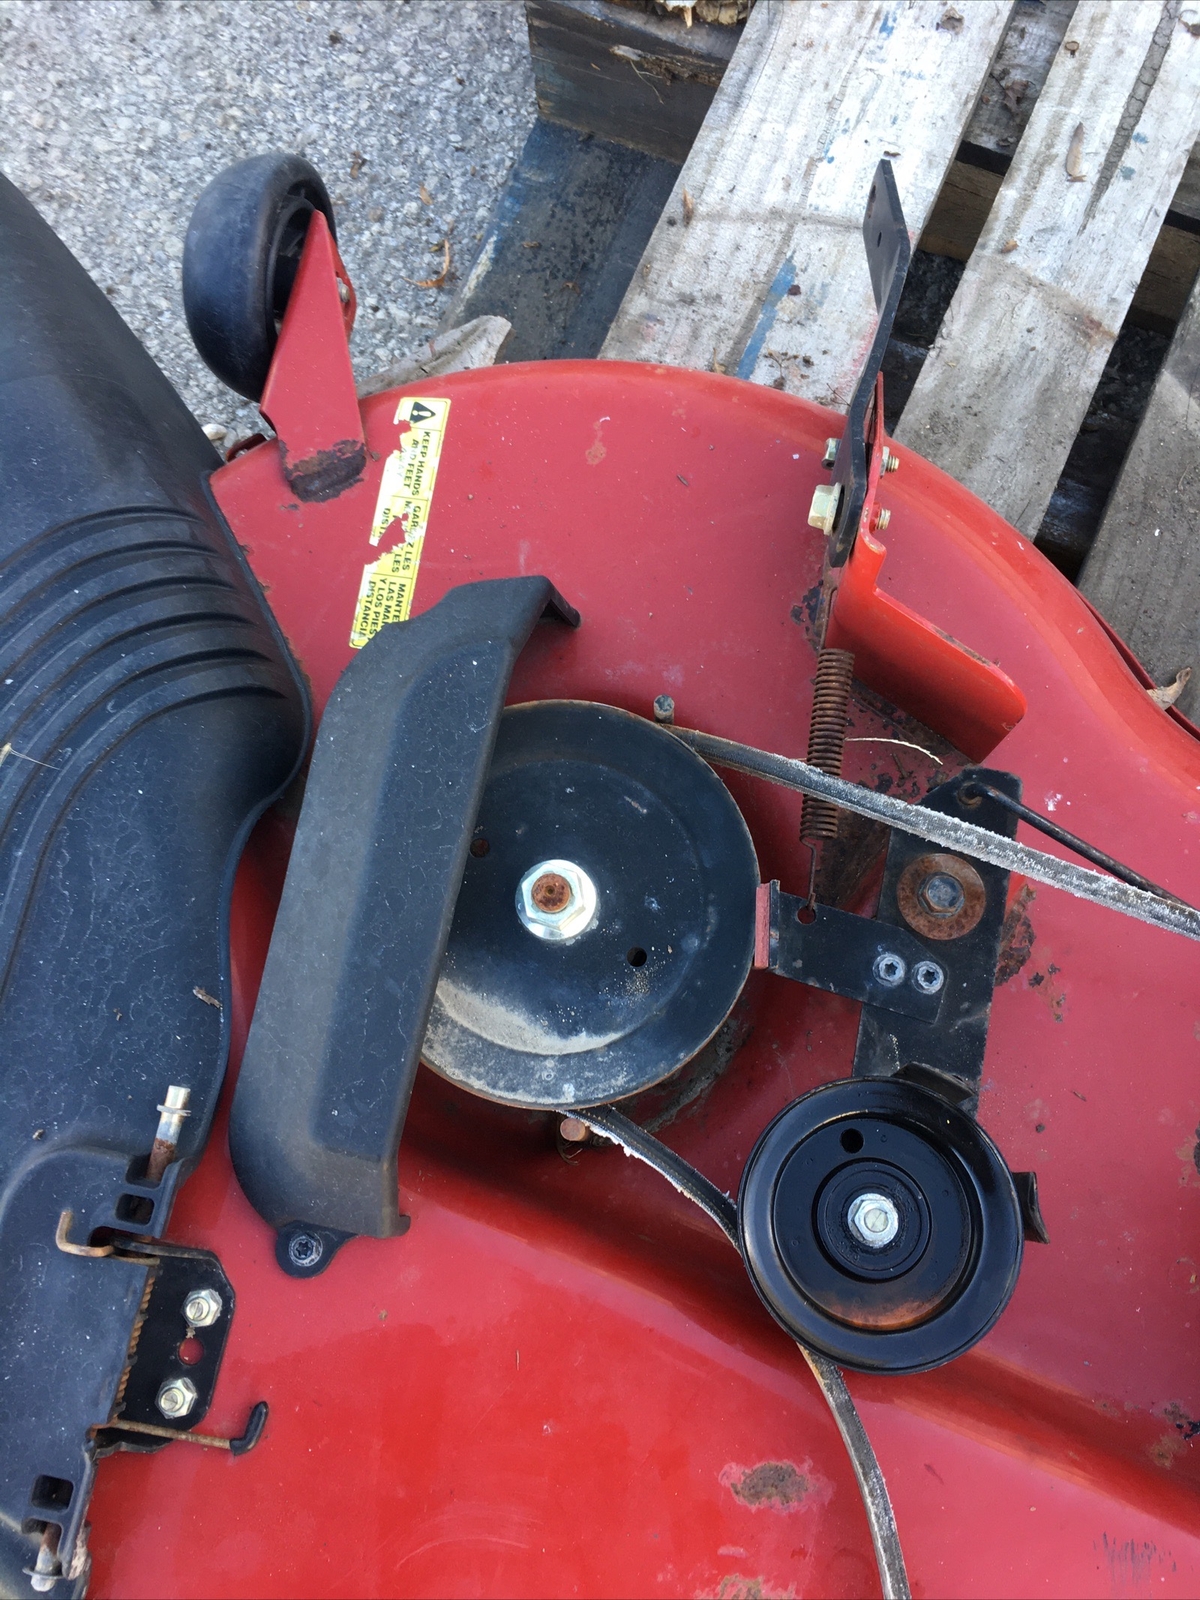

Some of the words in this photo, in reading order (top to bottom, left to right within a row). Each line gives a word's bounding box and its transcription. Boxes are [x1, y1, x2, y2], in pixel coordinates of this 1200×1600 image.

[420, 431, 431, 458] KEEP
[403, 463, 415, 489] FEET
[412, 460, 425, 496] HANDS
[407, 505, 421, 548] GARZ
[391, 553, 402, 573] LES
[402, 551, 413, 571] LES
[374, 587, 386, 608] LOS
[386, 581, 397, 602] LAS
[393, 583, 406, 622] MANTE
[358, 580, 377, 638] DISTANCIA
[369, 611, 380, 635] PIES
